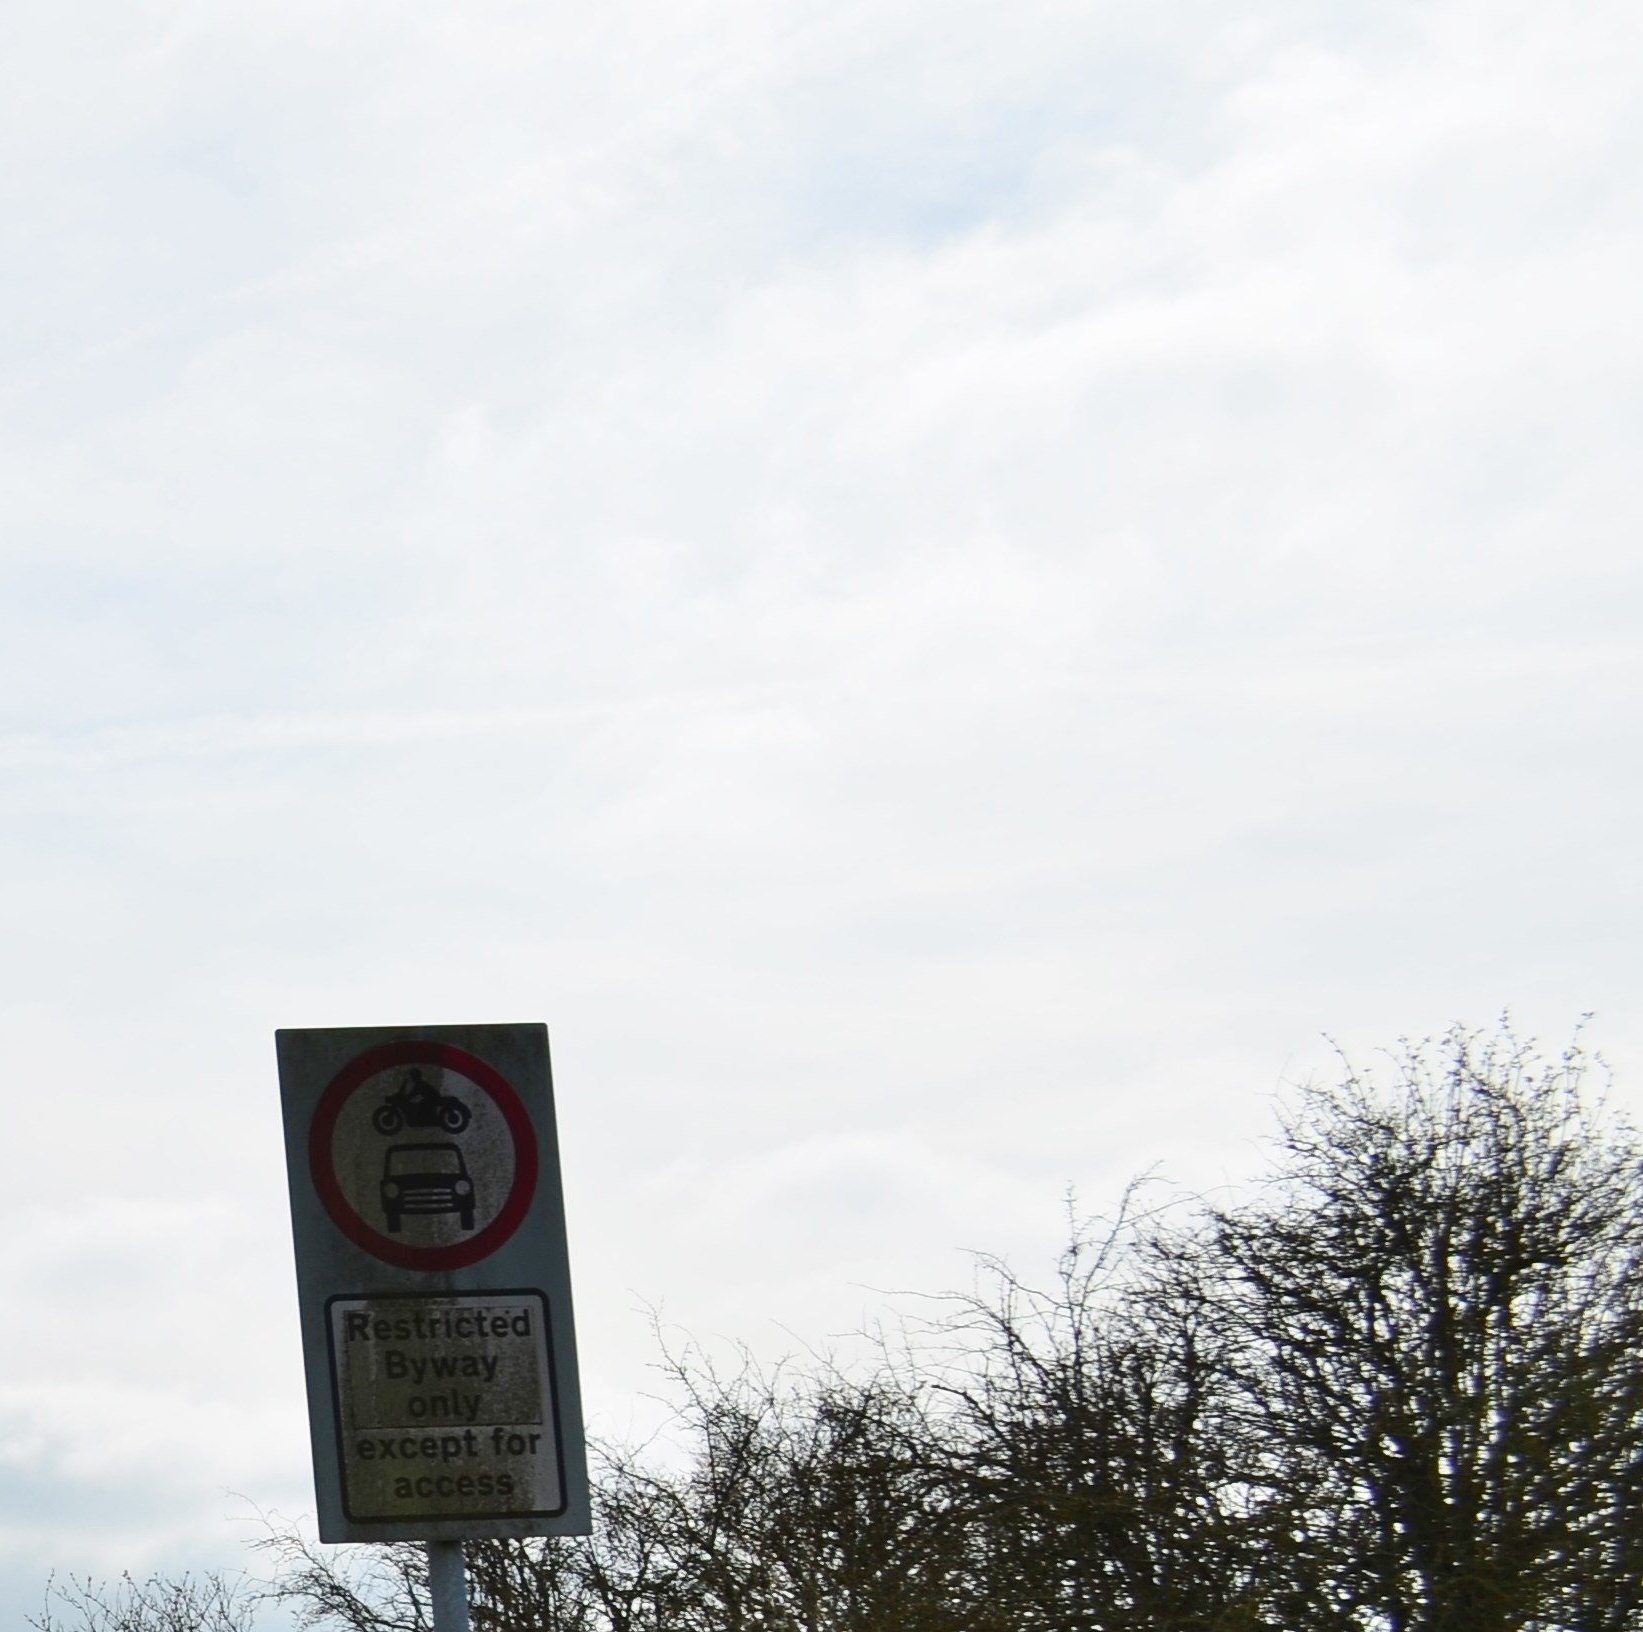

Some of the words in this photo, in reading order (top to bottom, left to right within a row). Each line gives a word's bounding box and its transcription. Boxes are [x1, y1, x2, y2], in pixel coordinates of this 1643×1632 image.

[347, 1308, 531, 1341] Restricted
[385, 1350, 498, 1384] Byway
[407, 1388, 482, 1422] only
[356, 1428, 478, 1463] except
[490, 1426, 542, 1456] for
[394, 1472, 515, 1499] access
